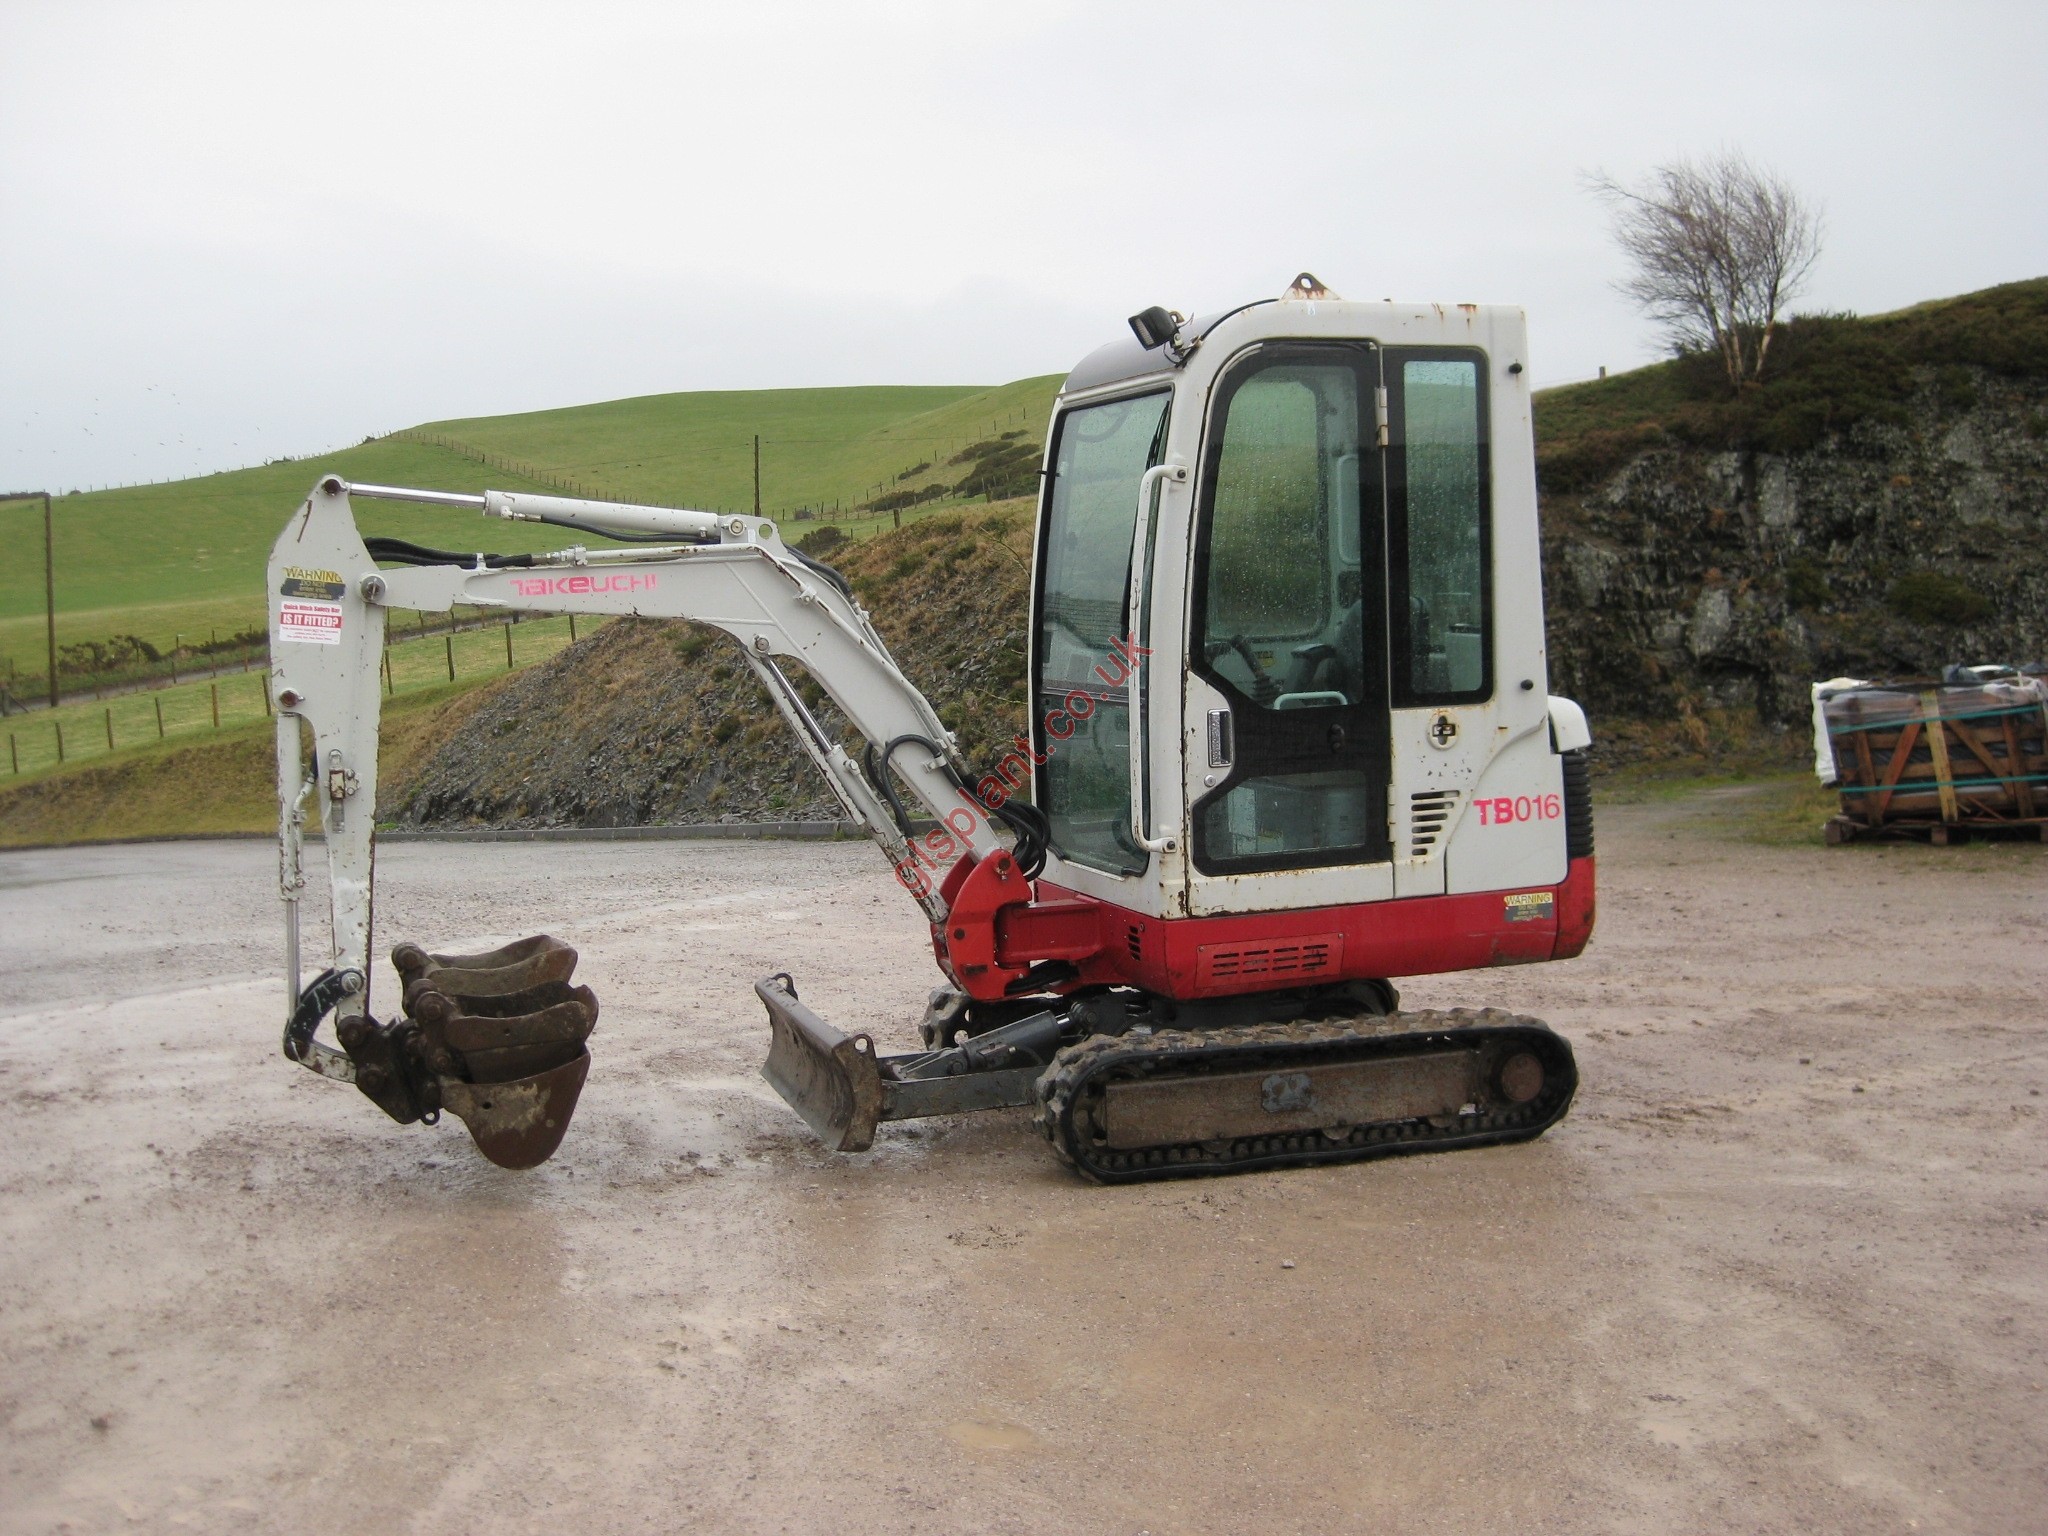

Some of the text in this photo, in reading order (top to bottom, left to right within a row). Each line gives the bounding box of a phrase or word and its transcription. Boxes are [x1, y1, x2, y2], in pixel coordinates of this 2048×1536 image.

[283, 613, 339, 627] IS IT FITTED?
[1473, 794, 1560, 825] TB016
[1506, 893, 1551, 905] WARNING
